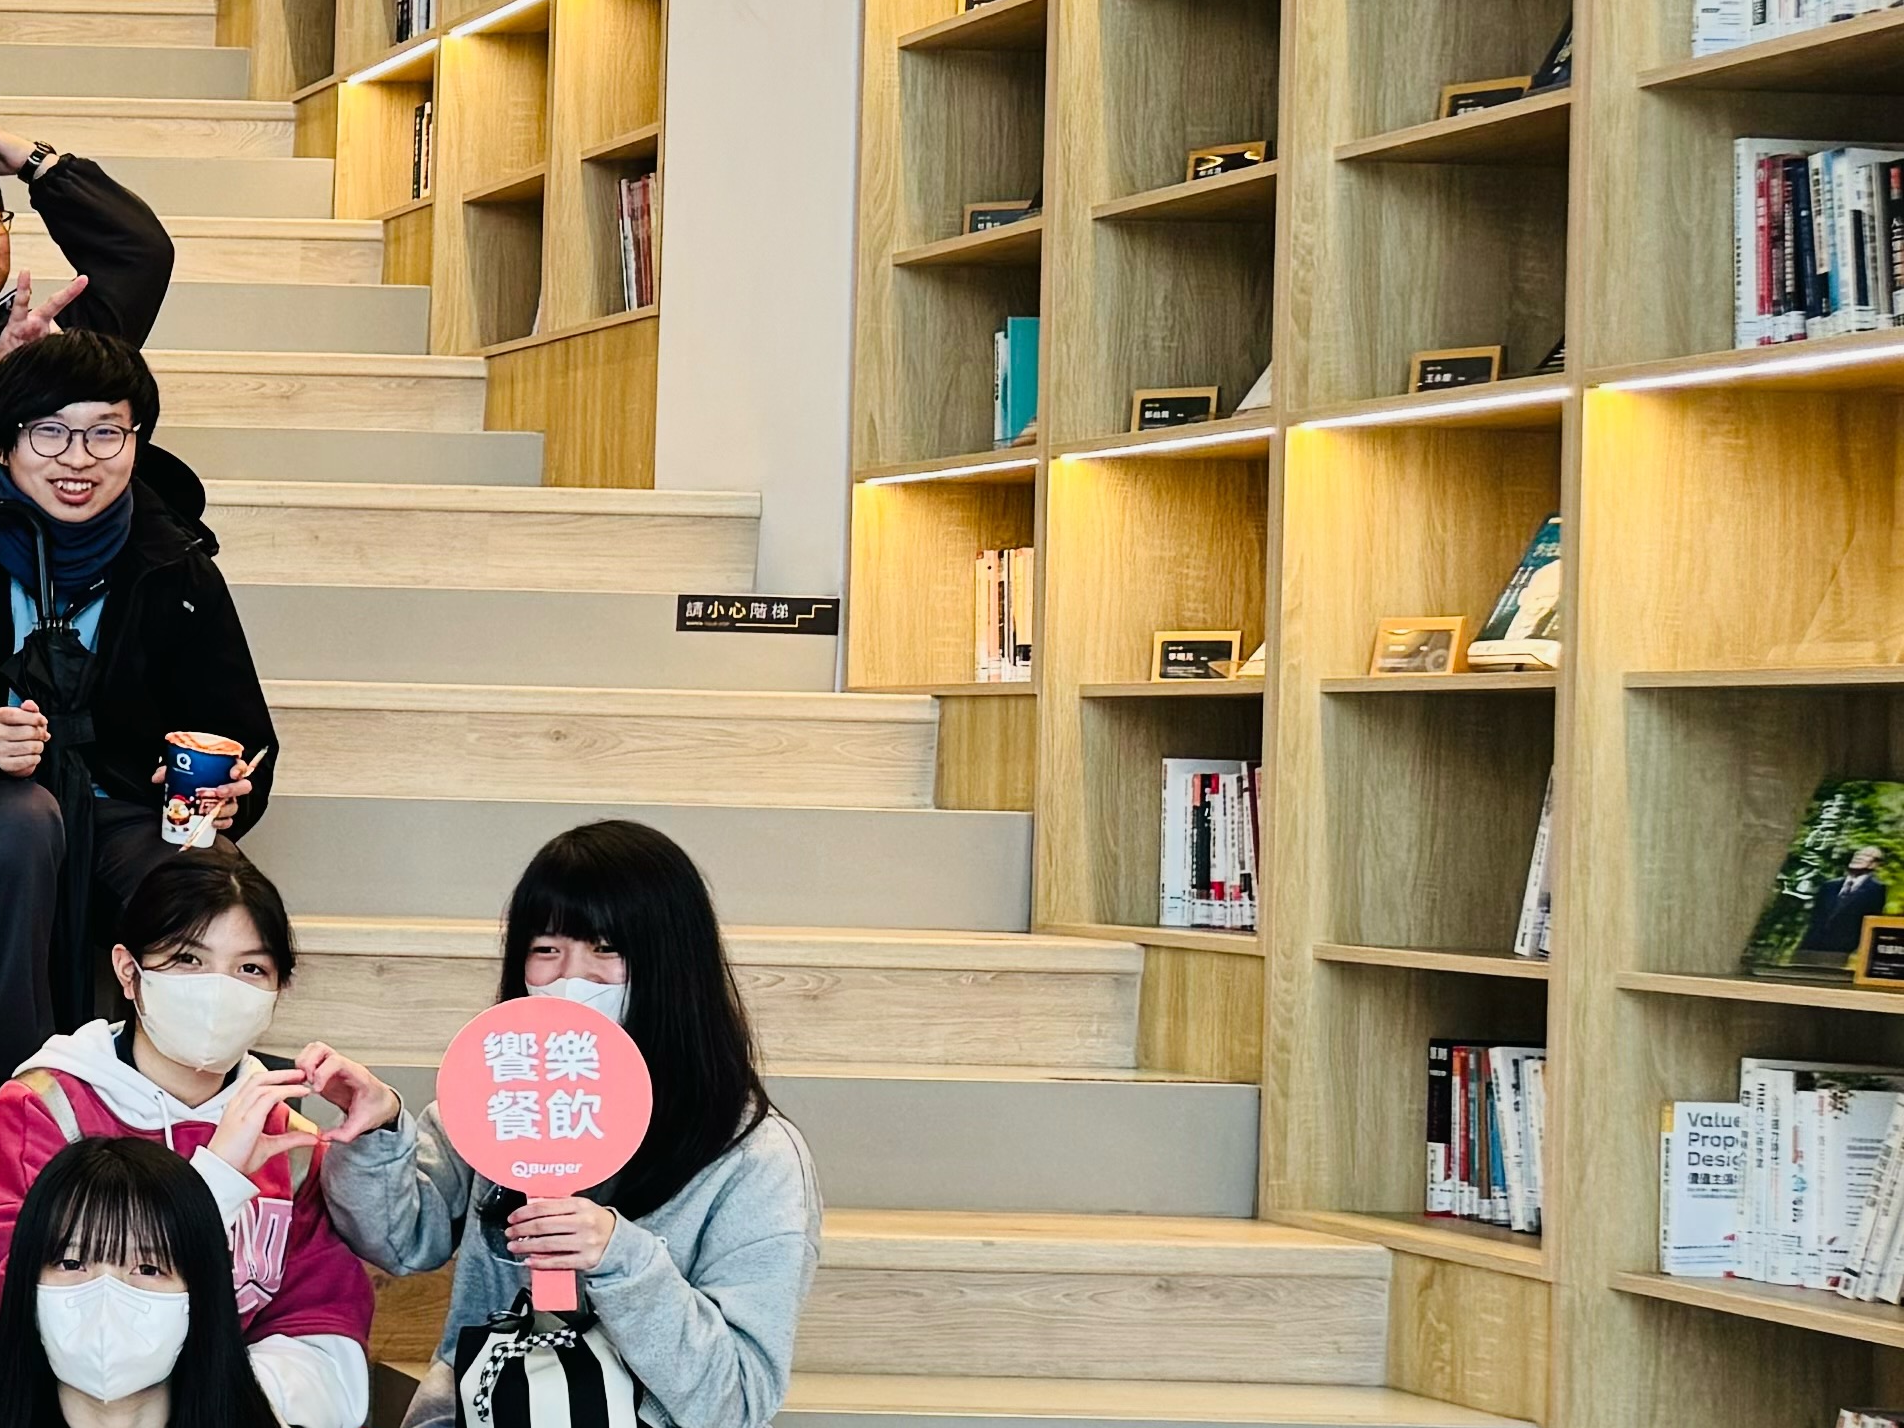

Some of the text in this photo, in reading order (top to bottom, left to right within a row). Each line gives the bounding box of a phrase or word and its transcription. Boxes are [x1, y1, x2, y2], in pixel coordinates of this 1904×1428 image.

[685, 600, 790, 620] 請小心階梯
[482, 1029, 601, 1084] 饗樂
[486, 1088, 605, 1142] 餐飲
[511, 1160, 583, 1178] QBurger
